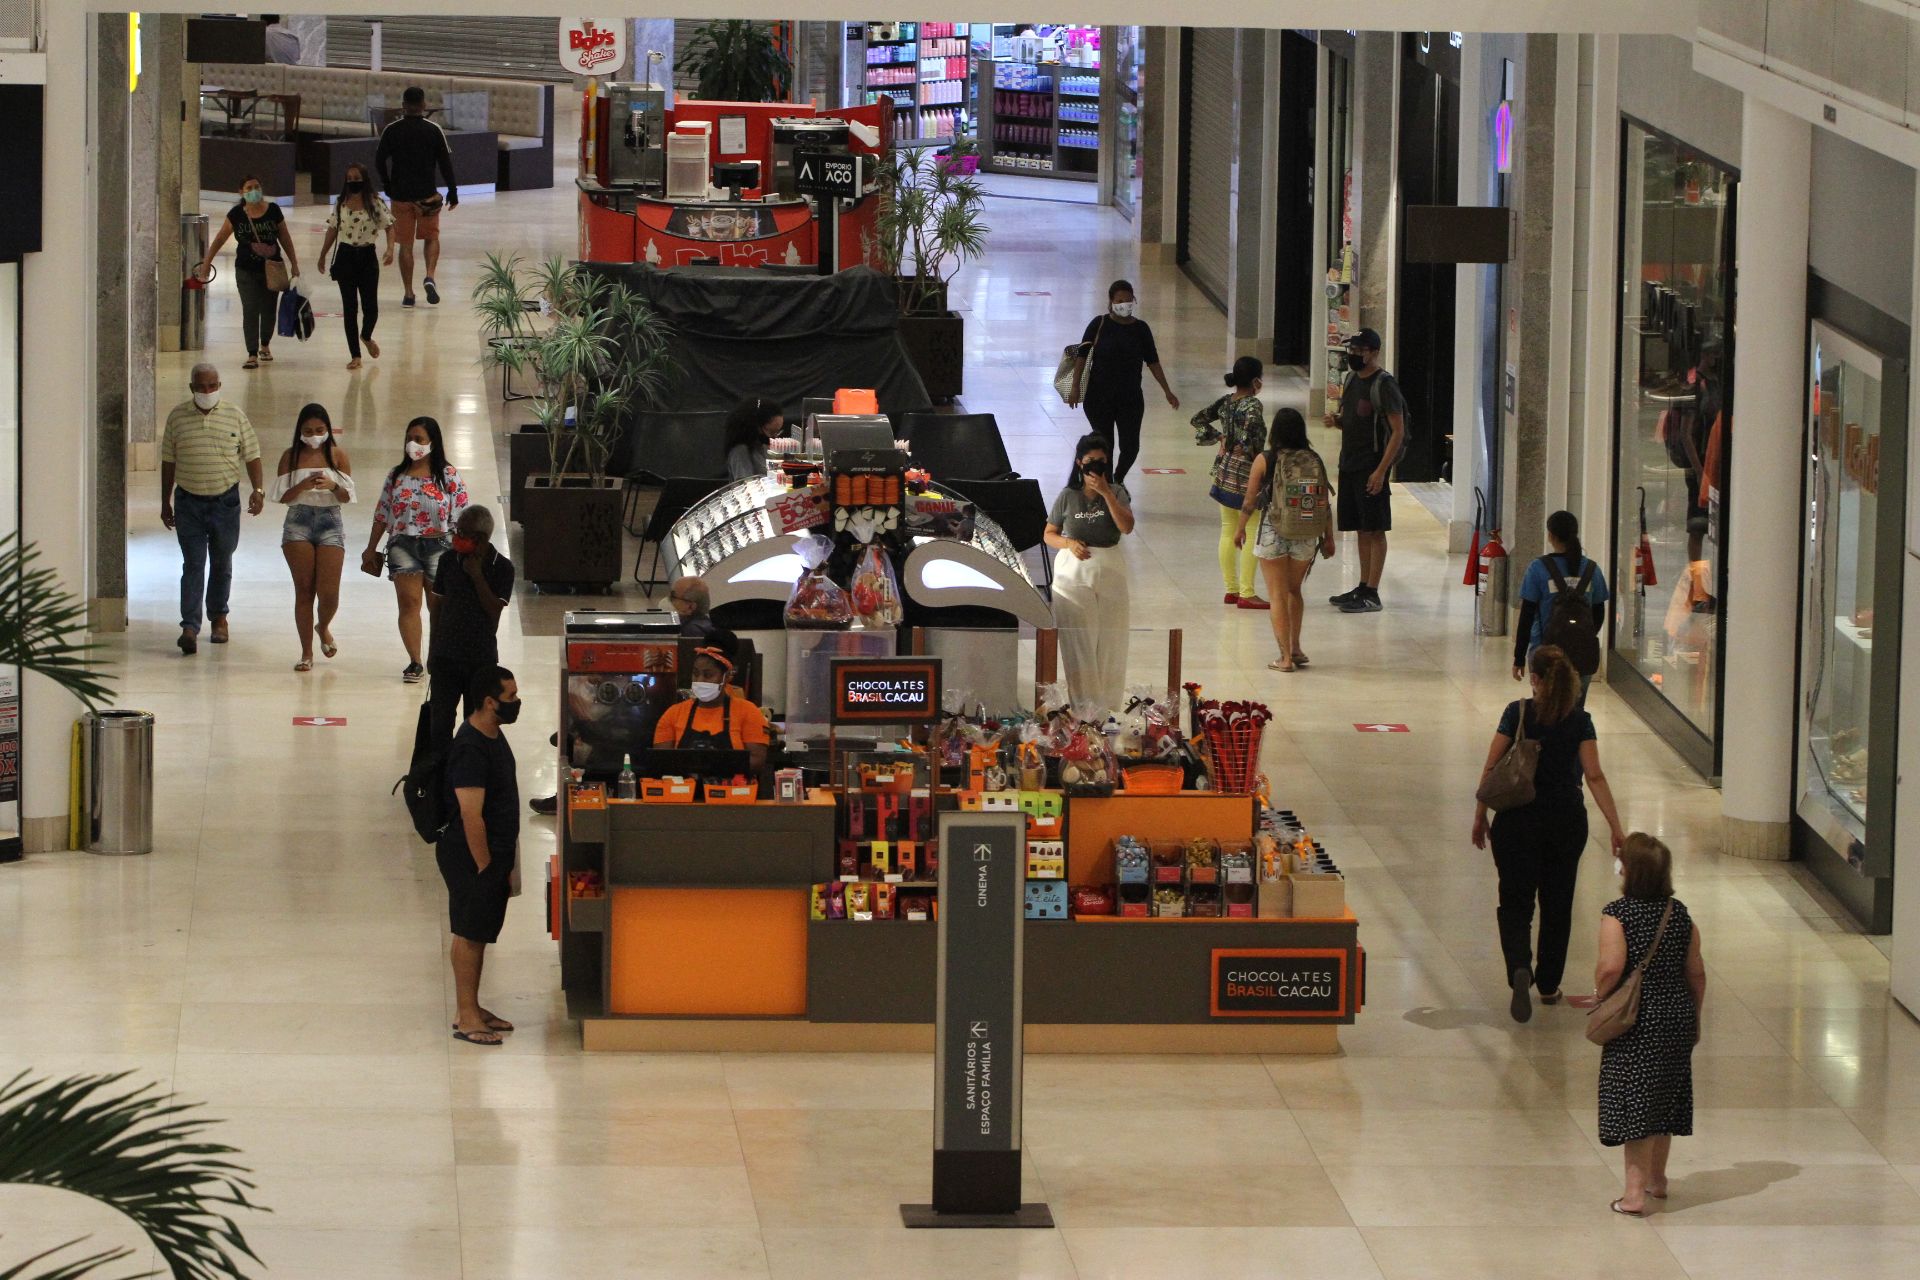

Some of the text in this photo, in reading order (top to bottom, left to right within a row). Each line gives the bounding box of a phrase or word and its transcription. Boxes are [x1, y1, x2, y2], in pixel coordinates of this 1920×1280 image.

[568, 28, 615, 51] Bob's
[579, 48, 616, 68] Shakes
[825, 170, 852, 184] AÇO
[848, 681, 924, 690] CHOCOLATES
[978, 865, 988, 907] CINEMA
[1227, 971, 1332, 982] CHOCOLATES
[965, 1041, 977, 1110] SANITÁRIOS
[980, 1041, 992, 1135] ESPAÇO FAMÍLIA
